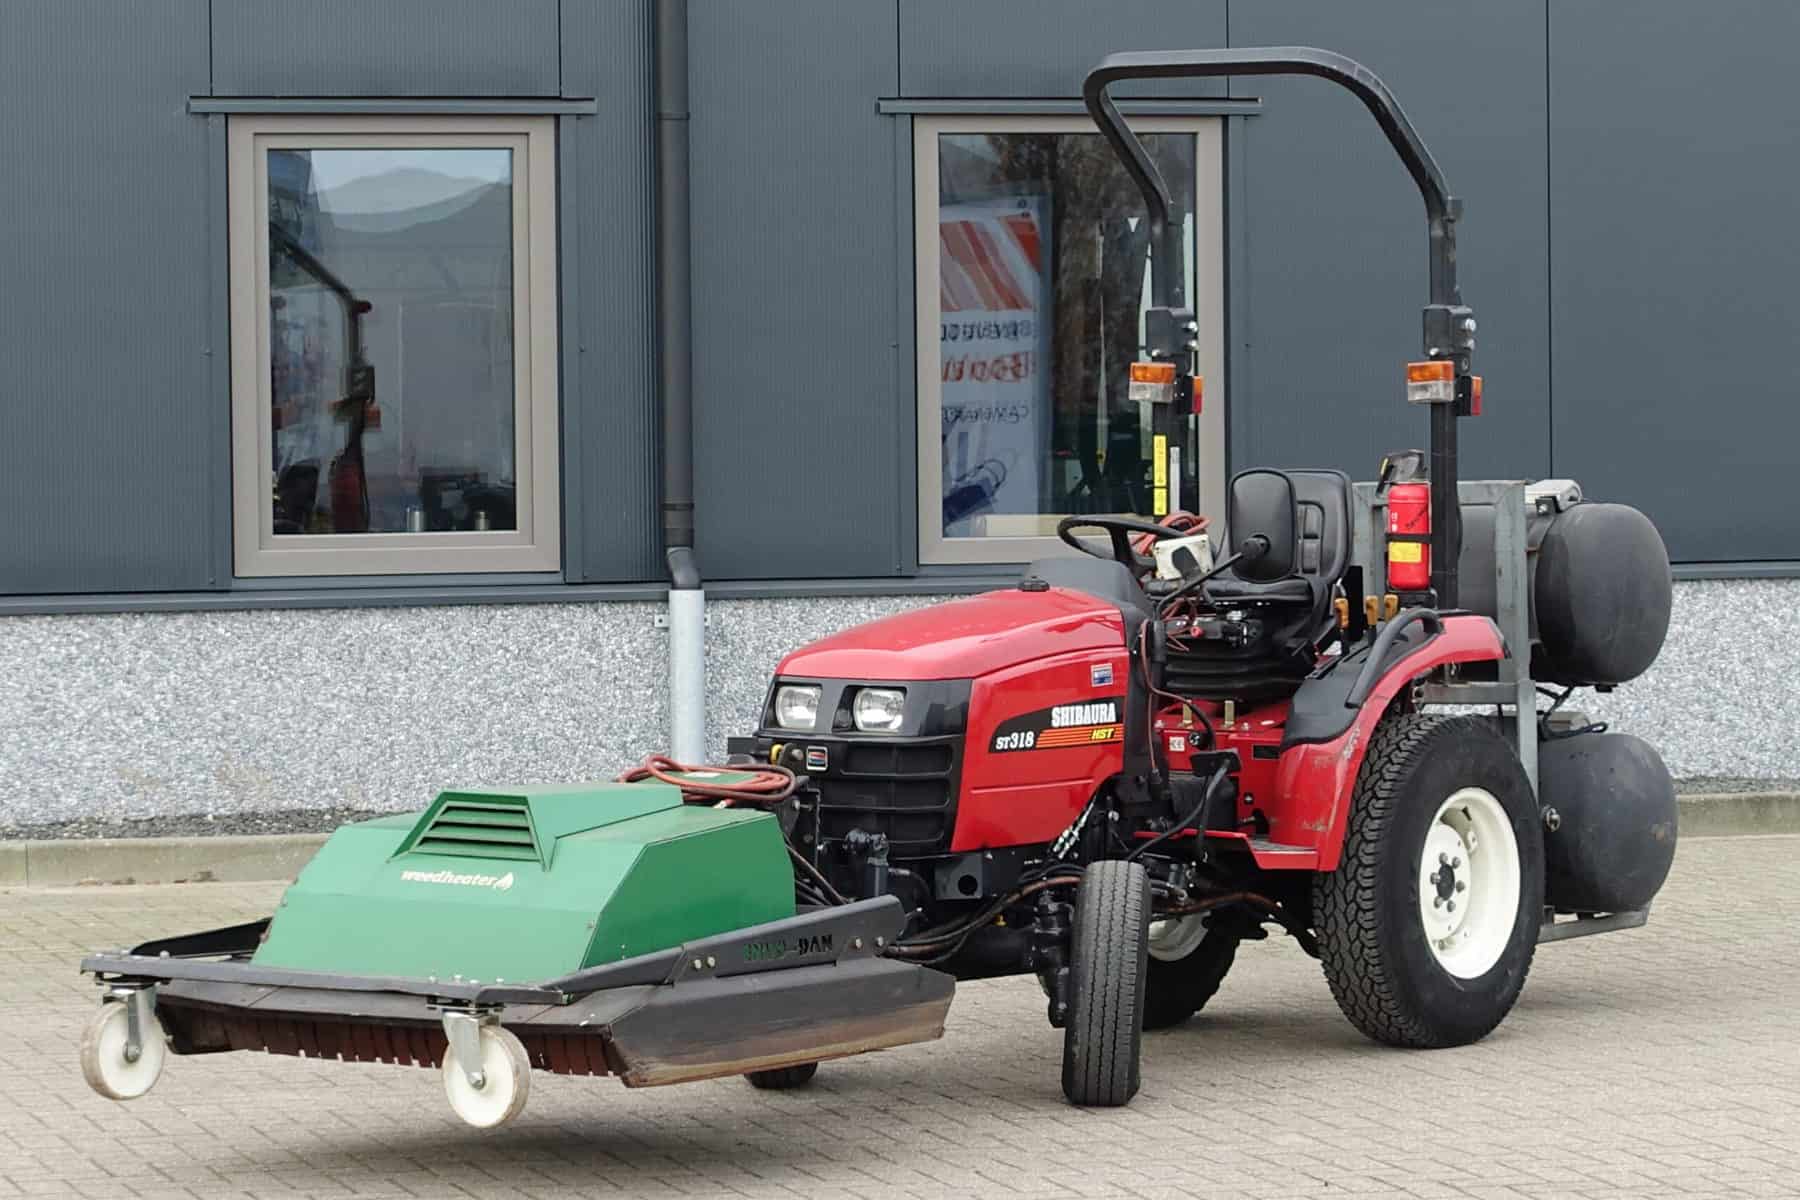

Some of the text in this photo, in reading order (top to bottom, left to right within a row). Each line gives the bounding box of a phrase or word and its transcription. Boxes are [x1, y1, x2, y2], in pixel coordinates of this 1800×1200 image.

[1051, 702, 1117, 728] SHIBAURA
[995, 731, 1035, 750] ST318
[1091, 728, 1115, 740] HST
[400, 870, 498, 888] weedheater
